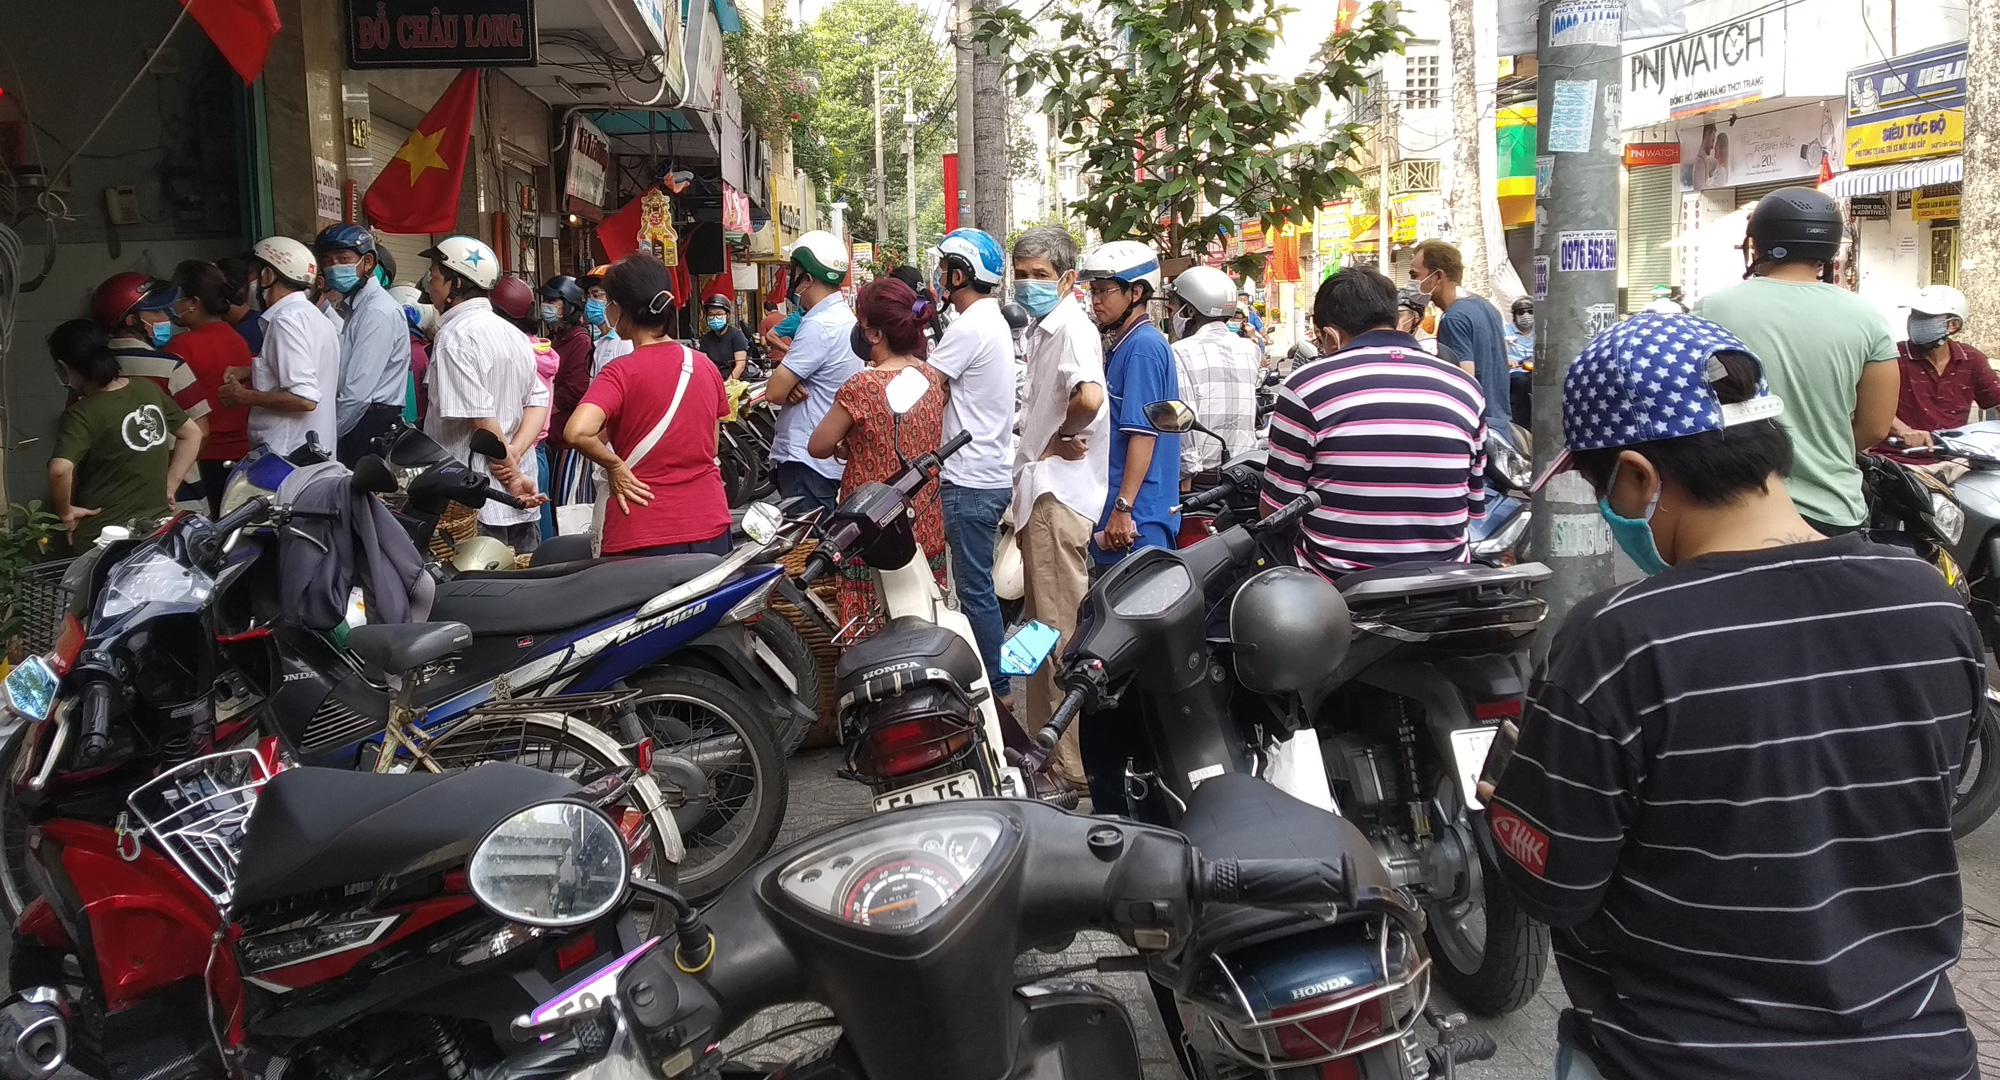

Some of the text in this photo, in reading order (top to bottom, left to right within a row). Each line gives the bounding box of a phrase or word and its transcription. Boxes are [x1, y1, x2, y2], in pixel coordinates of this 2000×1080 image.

[396, 6, 458, 49] CHÂU
[464, 13, 524, 48] LONG
[1646, 148, 1679, 157] WATCH
[283, 671, 320, 682] ONDA
[862, 661, 921, 681] HONDA
[1291, 975, 1354, 1000] HONDA
